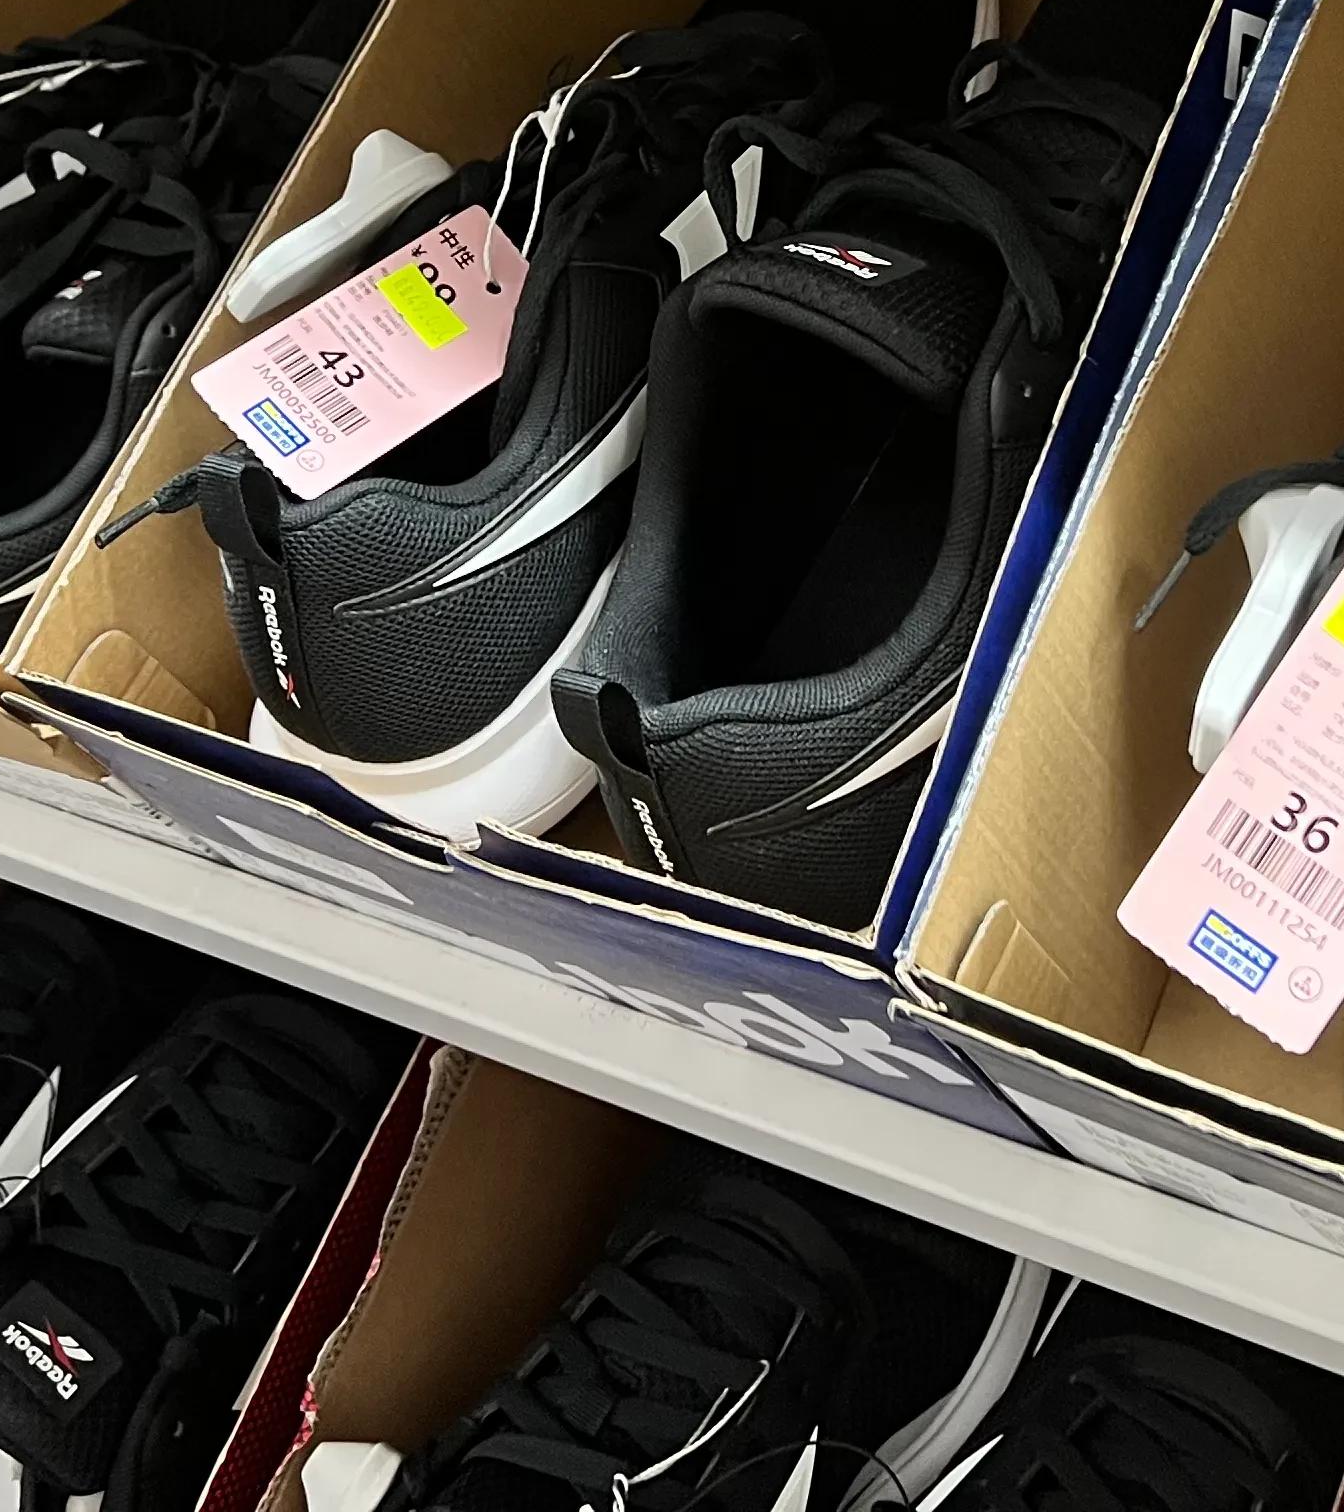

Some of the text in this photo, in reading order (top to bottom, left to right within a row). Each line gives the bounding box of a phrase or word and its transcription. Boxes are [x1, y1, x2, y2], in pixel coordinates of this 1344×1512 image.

[439, 227, 475, 270] 中性
[252, 362, 337, 445] JM00052500
[318, 349, 364, 388] 43
[258, 585, 288, 667] Reebok
[631, 796, 674, 873] Reebok
[1269, 791, 1340, 854] 36
[1201, 852, 1329, 953] JM00111254
[1, 1324, 78, 1400] Reebok
